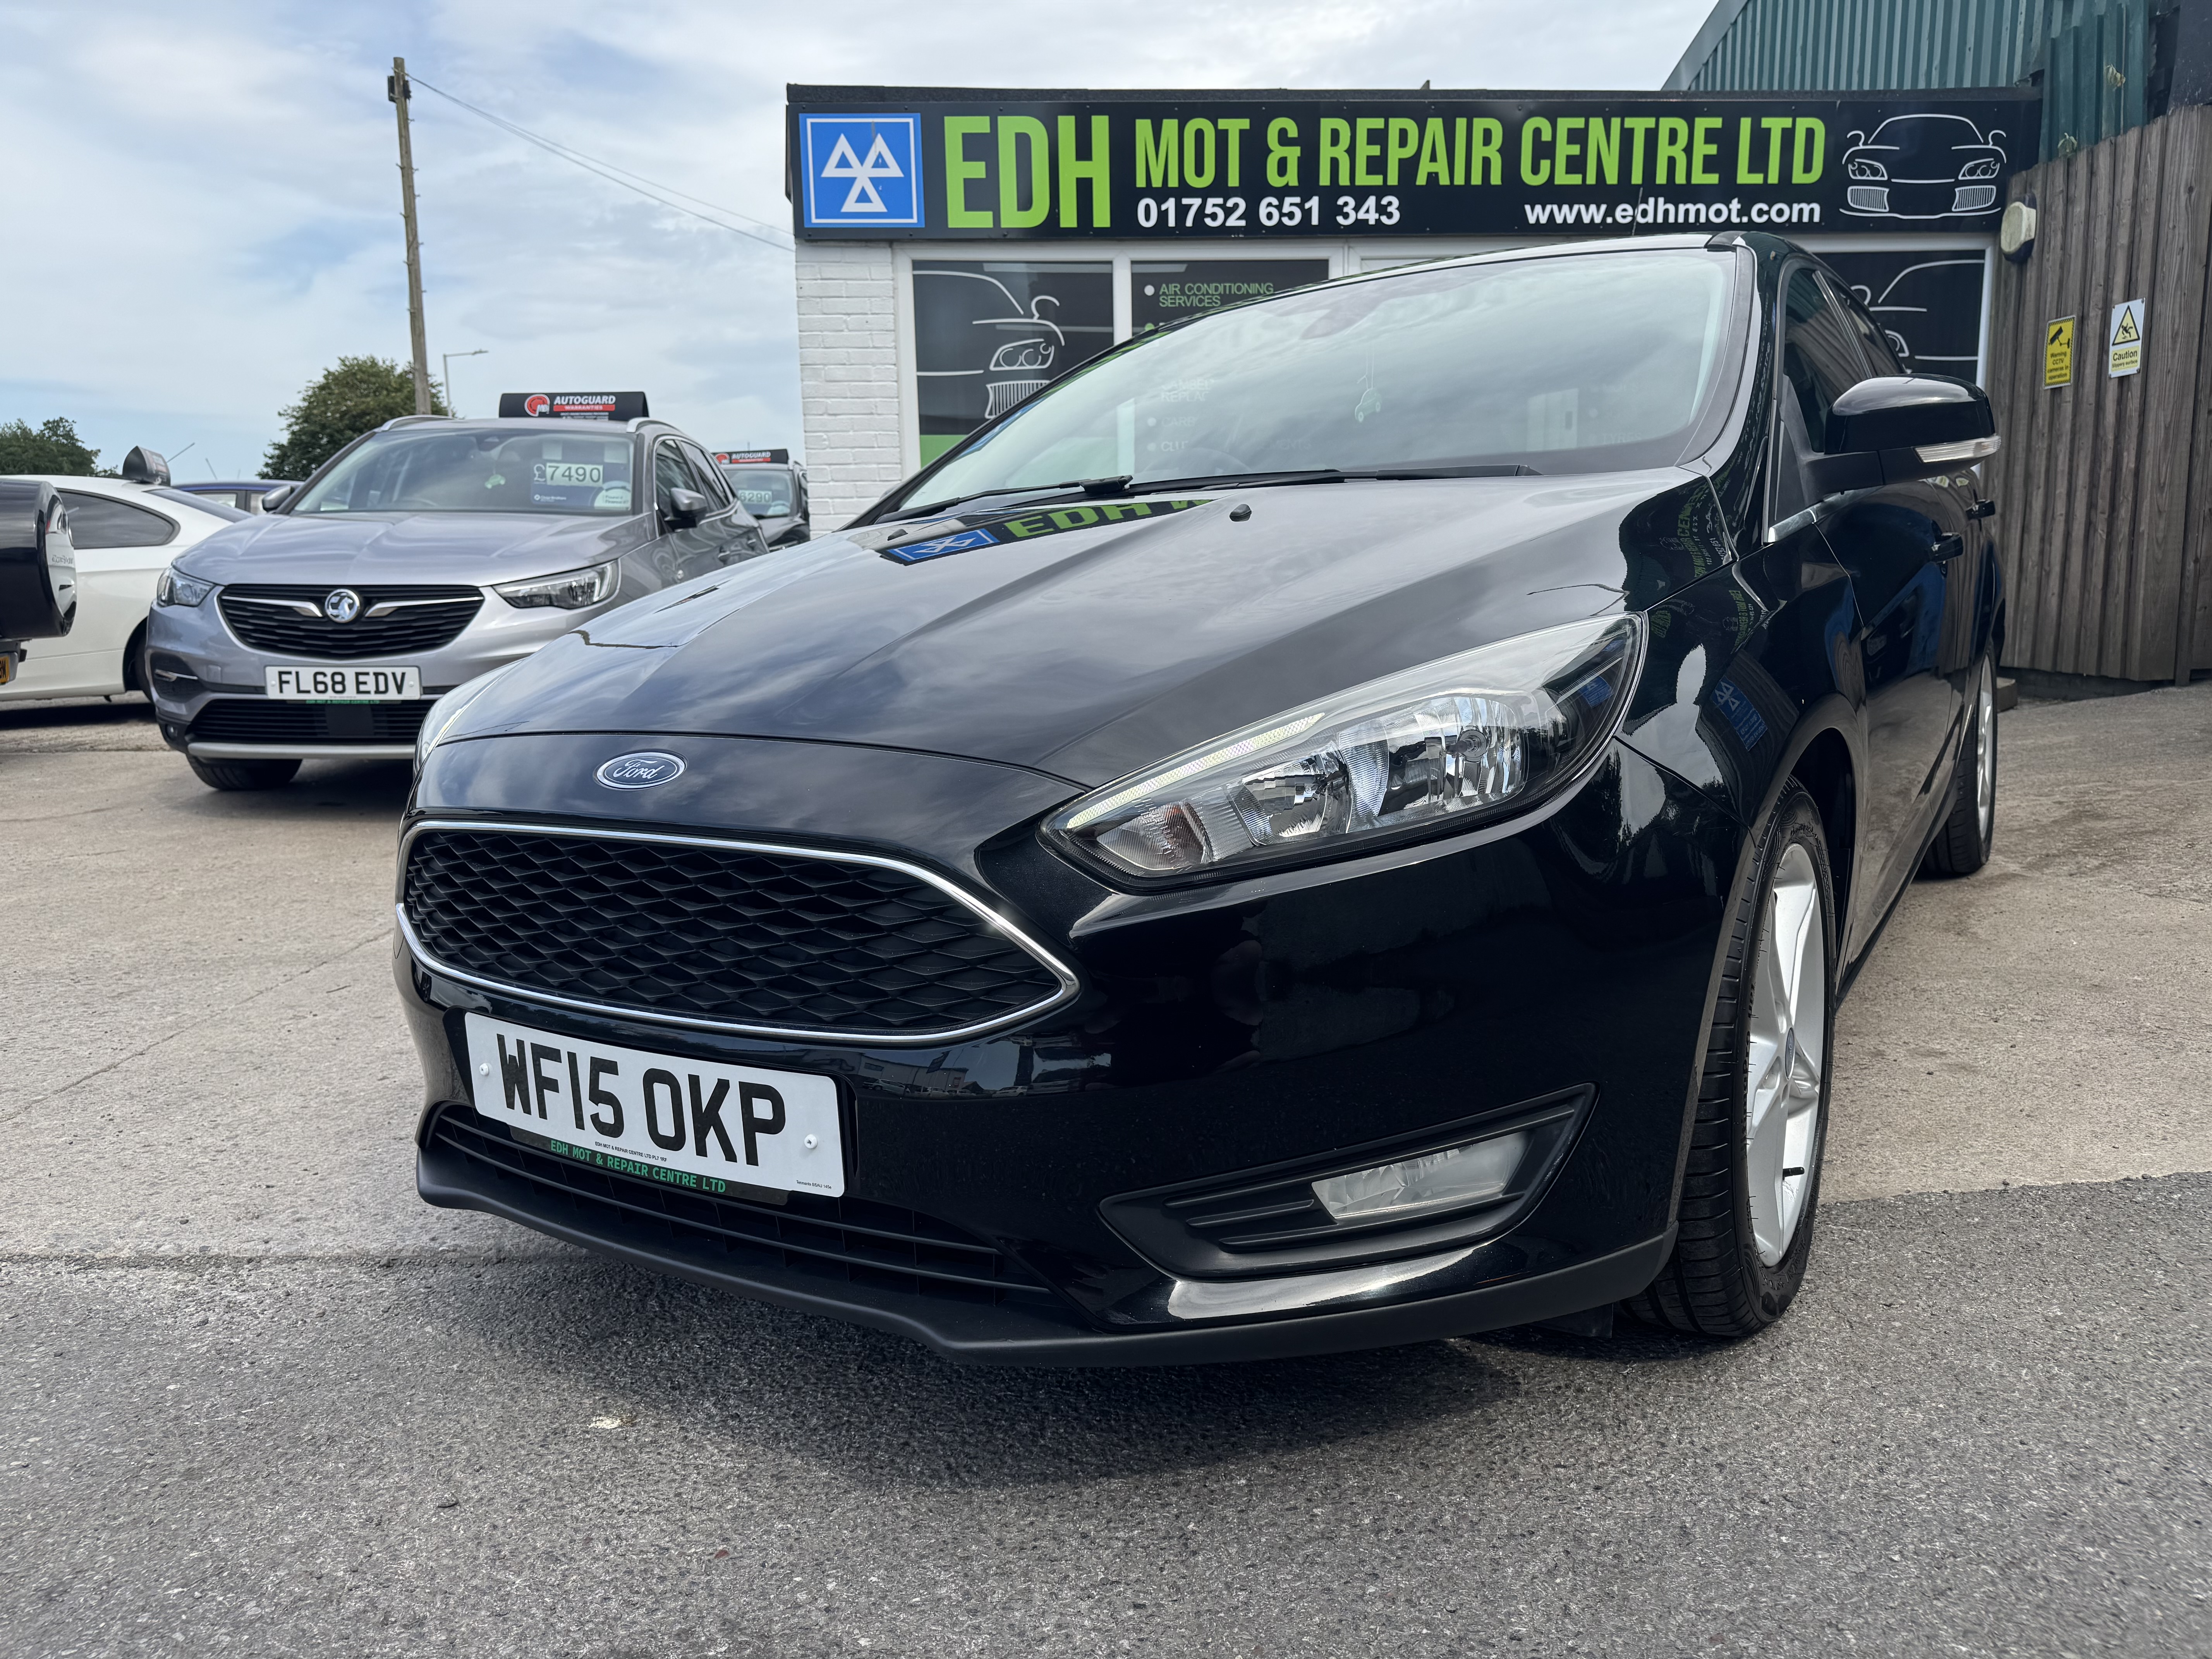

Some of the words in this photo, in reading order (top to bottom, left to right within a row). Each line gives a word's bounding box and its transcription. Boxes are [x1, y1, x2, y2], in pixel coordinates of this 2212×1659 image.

[944, 115, 1111, 228] EDH
[1136, 118, 1250, 188] MOT
[1266, 117, 1301, 187] &
[1319, 118, 1503, 186] REPAIR
[1521, 117, 1723, 186] CENTRE
[1737, 117, 1825, 184] LTD
[1137, 197, 1246, 228] 01752
[1259, 196, 1319, 226] 651
[1336, 196, 1400, 225] 343
[1525, 197, 1820, 224] www.edhmot.com
[1159, 283, 1180, 295] AIR
[1185, 283, 1274, 295] CONDITIONING
[1159, 295, 1221, 307] SERVICES
[2113, 350, 2137, 361] Caution
[553, 395, 616, 405] AUTOGUARD
[278, 671, 346, 694] FL68
[354, 672, 406, 694] EDV
[613, 759, 665, 780] Ford
[496, 1033, 625, 1138] WF15
[642, 1068, 786, 1166] OKP
[551, 1140, 568, 1155] EDH
[572, 1146, 592, 1161] MOT
[596, 1152, 603, 1165] &
[607, 1156, 648, 1177] REPAIR
[652, 1167, 697, 1188] CENTRE
[702, 1177, 726, 1193] LTD
